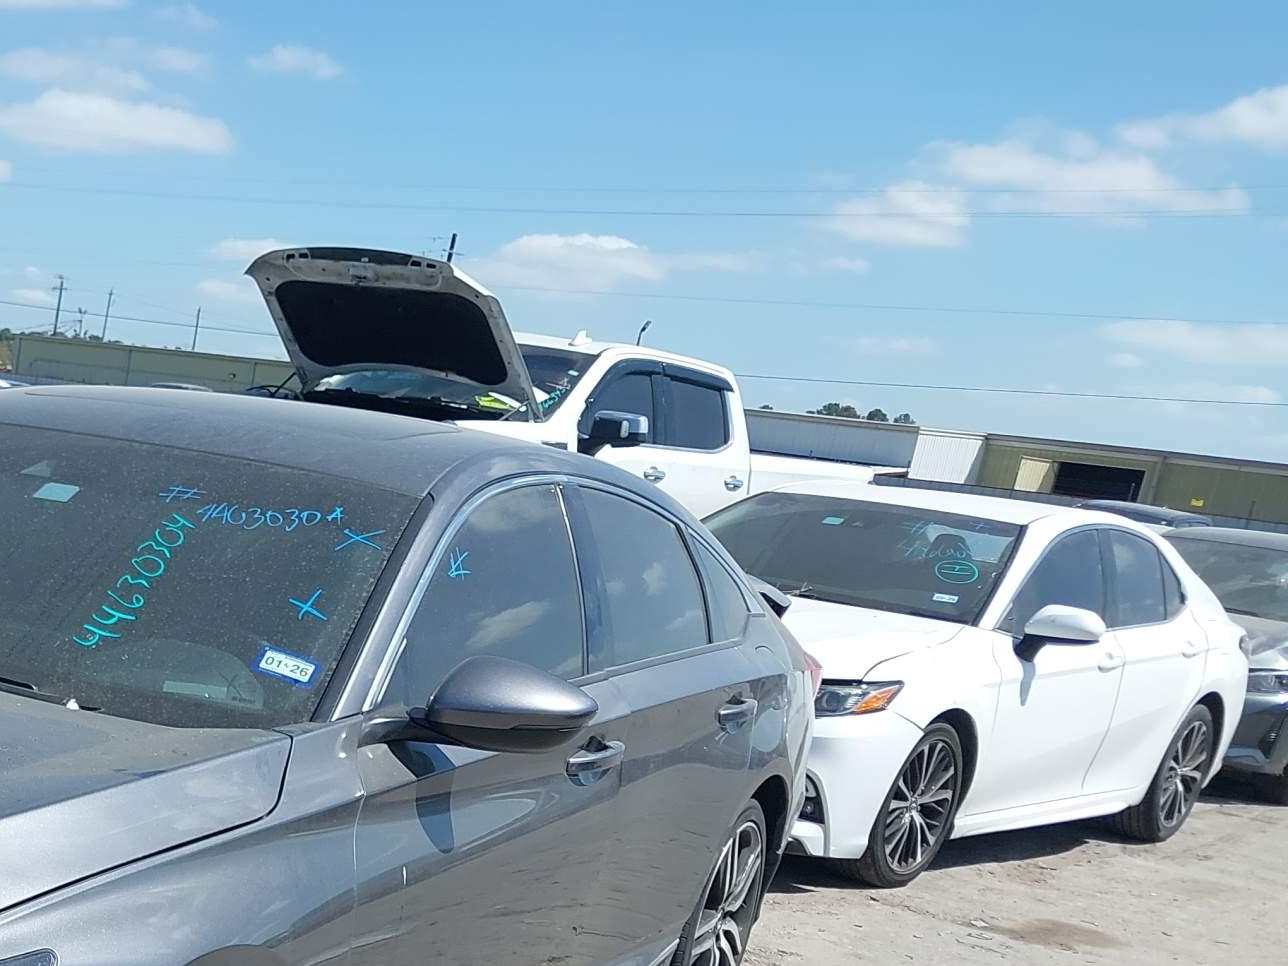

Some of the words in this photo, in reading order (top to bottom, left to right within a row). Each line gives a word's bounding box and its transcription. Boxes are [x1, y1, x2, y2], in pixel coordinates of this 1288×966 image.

[72, 512, 196, 647] 44630304
[264, 656, 283, 669] 01
[289, 664, 310, 677] 26
